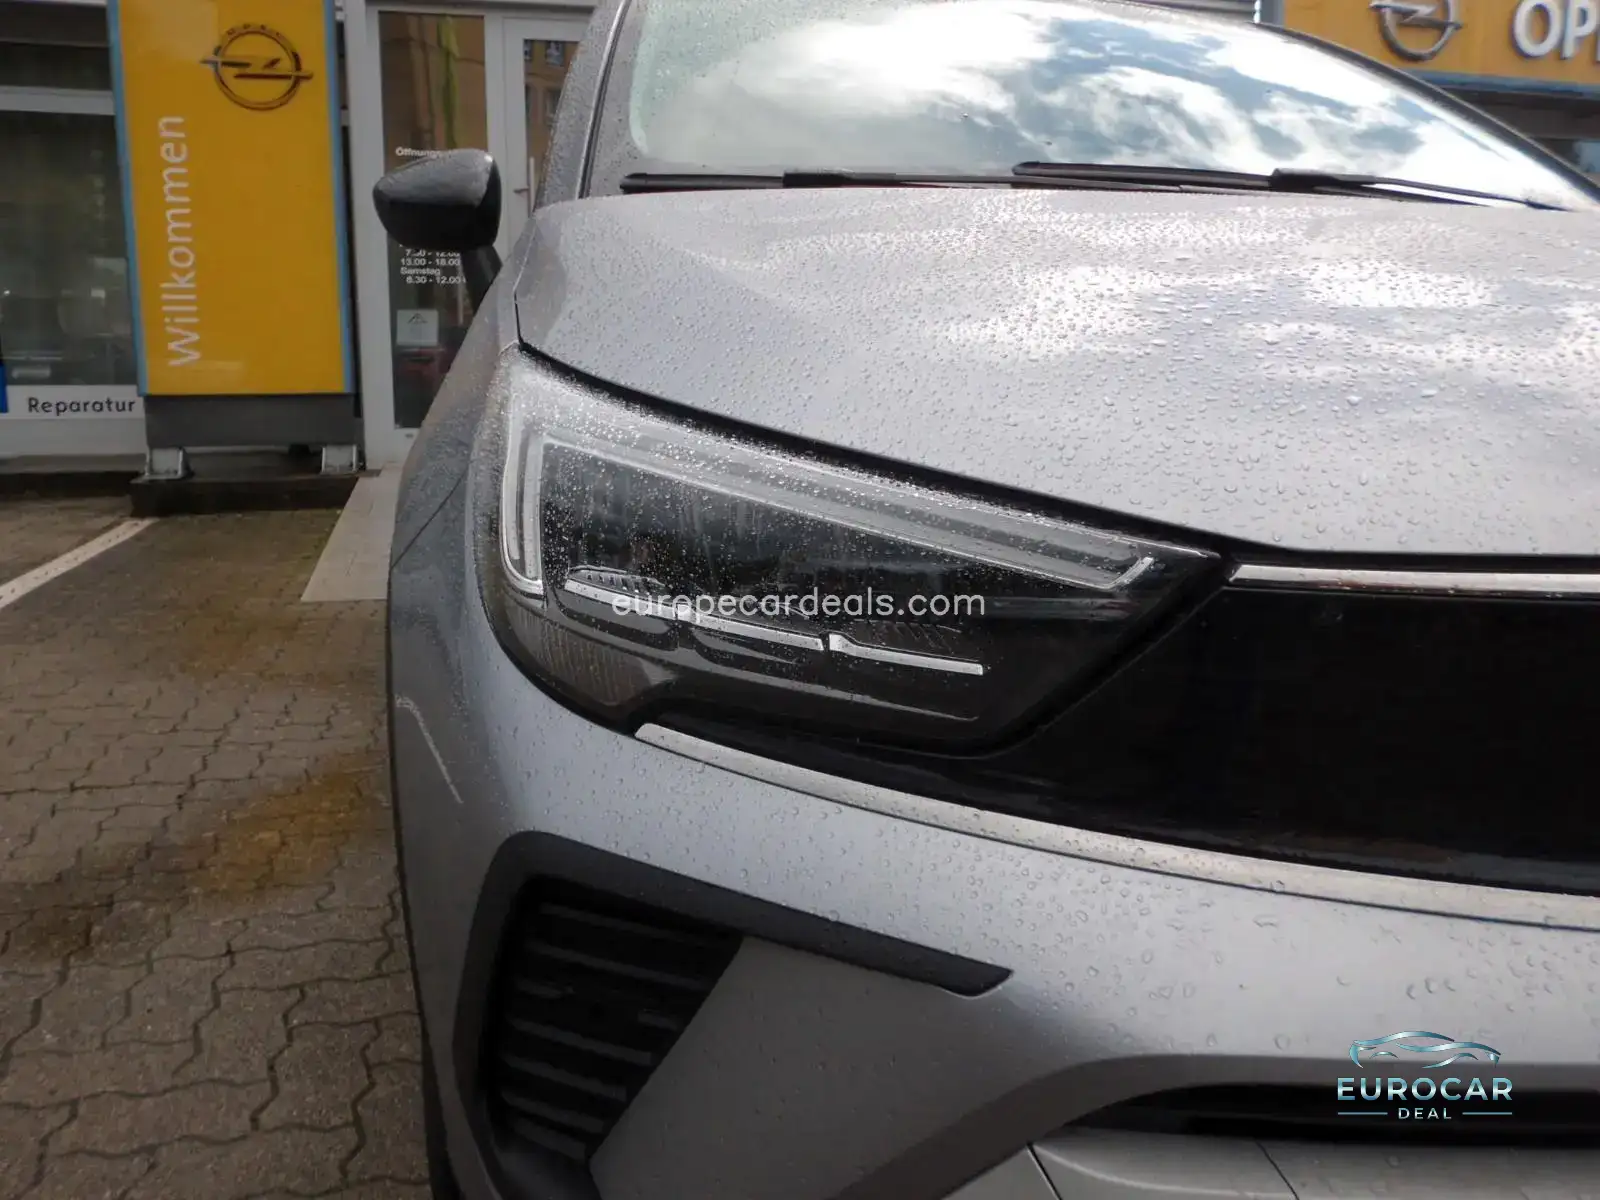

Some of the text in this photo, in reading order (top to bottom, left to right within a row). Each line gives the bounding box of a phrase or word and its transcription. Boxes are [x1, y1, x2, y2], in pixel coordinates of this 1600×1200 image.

[1512, 0, 1600, 61] OP
[158, 115, 201, 367] Willkommen
[400, 266, 441, 276] Samstag
[28, 396, 136, 416] Reparatur
